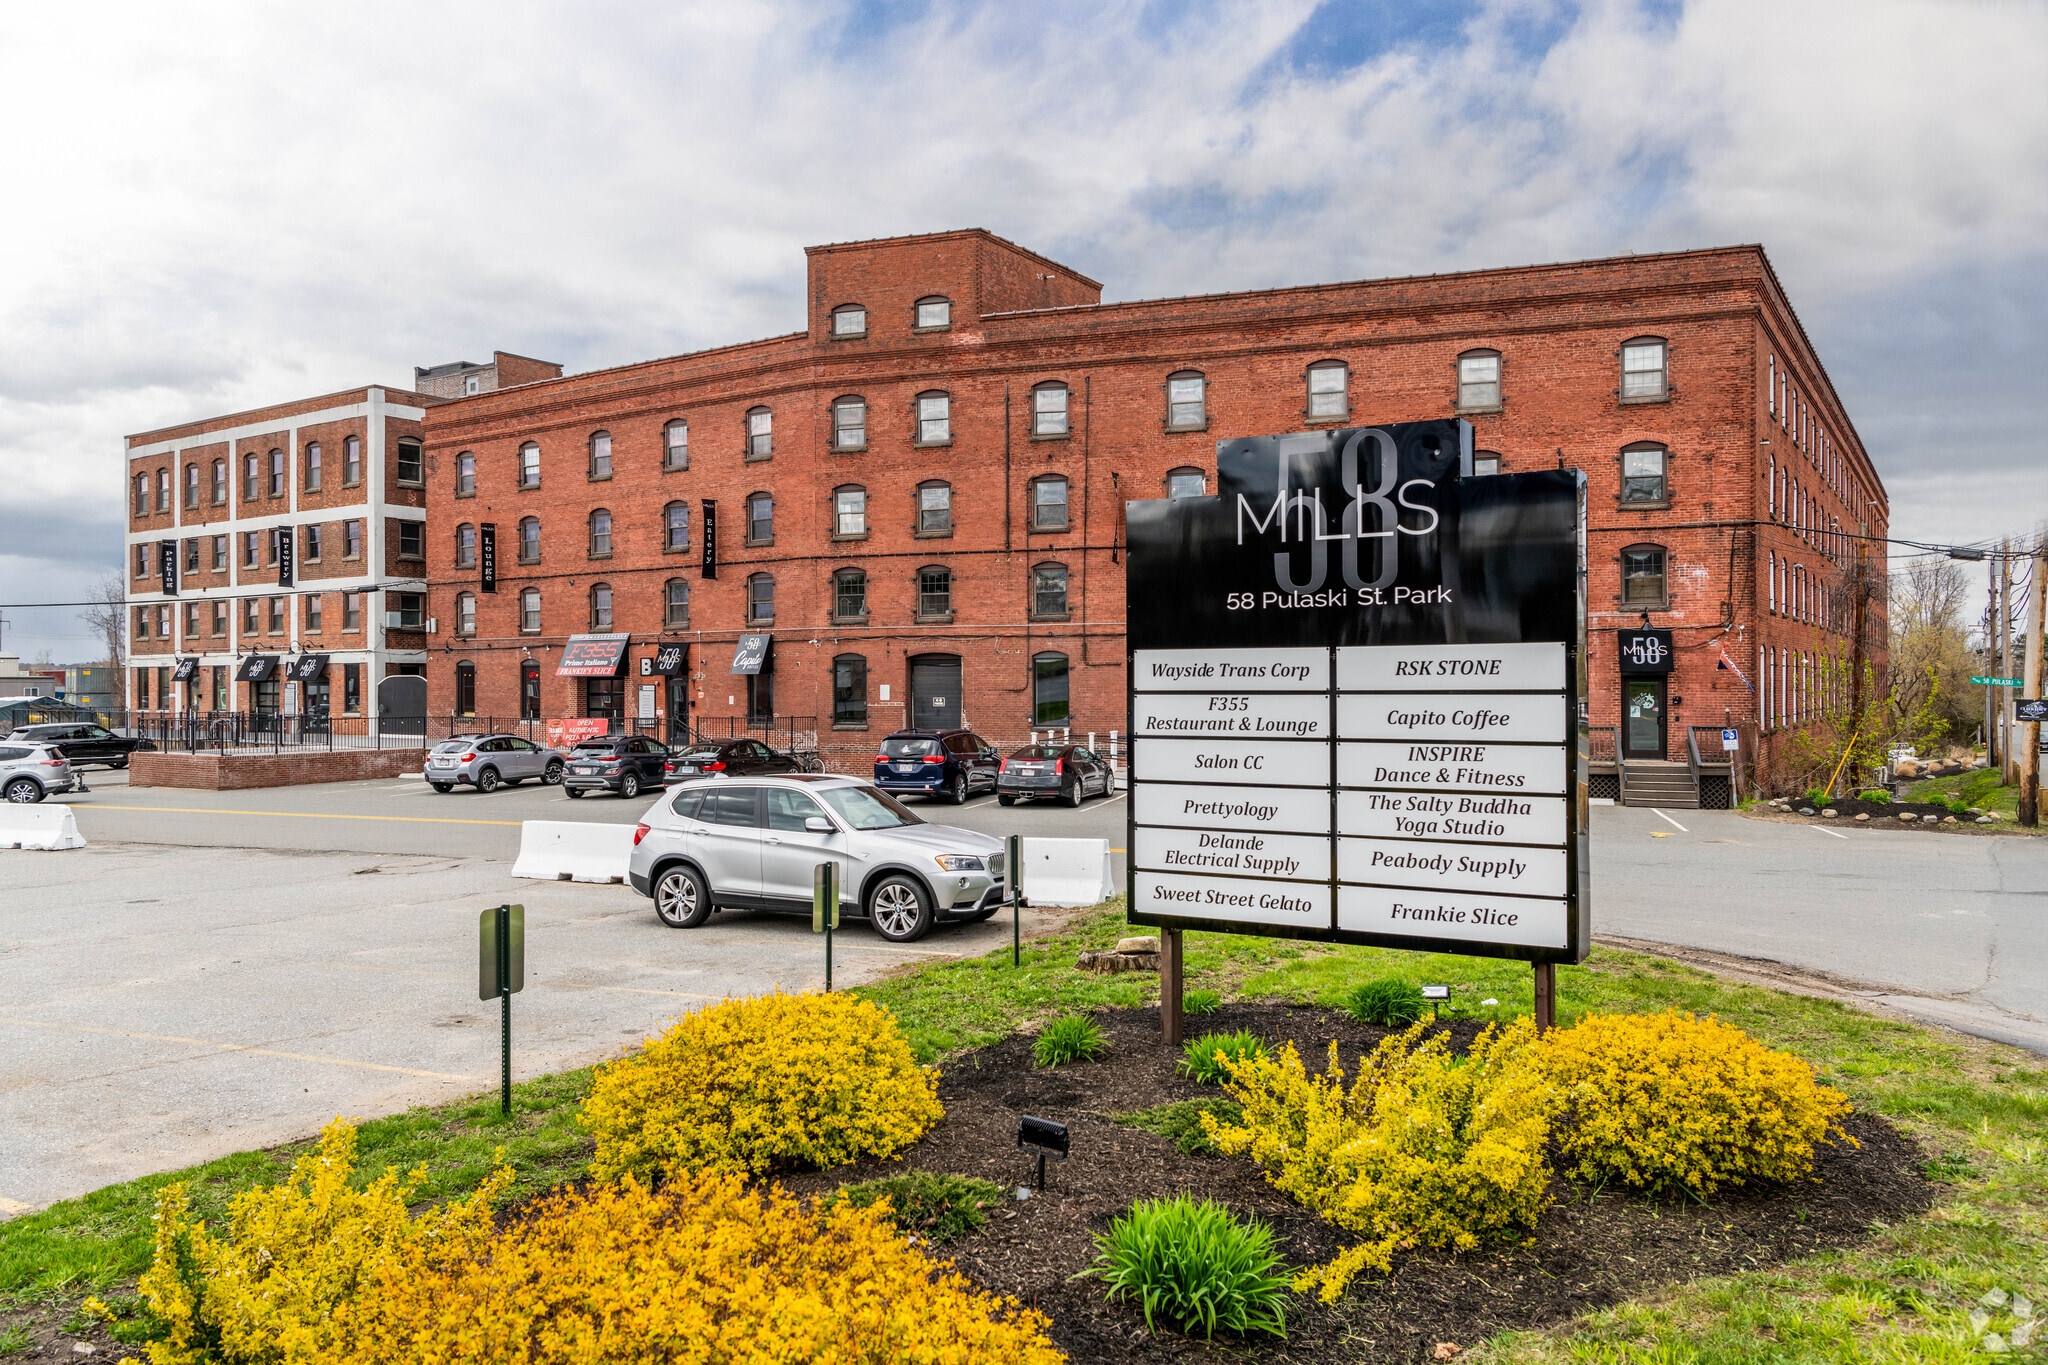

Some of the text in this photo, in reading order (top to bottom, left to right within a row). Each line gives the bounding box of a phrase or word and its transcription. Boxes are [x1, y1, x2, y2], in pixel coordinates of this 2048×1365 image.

[1236, 478, 1440, 546] MILLS
[1274, 428, 1399, 596] 58
[705, 518, 713, 564] Eatery
[282, 537, 291, 578] Brewery
[484, 537, 493, 581] Lounge
[165, 550, 174, 588] Parking
[1226, 584, 1453, 610] 58 Pulaski St. Park
[565, 641, 621, 659] F355
[659, 647, 681, 670] 58
[1623, 645, 1668, 656] MILLS
[1632, 636, 1660, 665] 58
[564, 659, 608, 667] Prime Italiano
[593, 667, 613, 675] SLICE
[641, 658, 652, 676] B
[1152, 663, 1310, 682] Wayside Trans Corp
[1395, 659, 1502, 676] RSK STONE
[1991, 678, 2014, 686] PULASKI
[1208, 697, 1249, 711] F355
[1146, 716, 1318, 736] Restaurant & Lounge
[1387, 709, 1510, 730] Capito Coffee
[1194, 754, 1264, 771] Salon CC
[1407, 746, 1486, 762] INSPIRE
[1373, 767, 1525, 787] Dance & Fitness
[1183, 799, 1279, 821] Prettyology
[1368, 794, 1532, 816] The Salty Buddha
[1395, 816, 1505, 836] Yoga Studio
[1198, 833, 1265, 851] Delande
[1164, 850, 1300, 876] Electrical Supply
[1370, 851, 1527, 880] Peabody Supply
[1153, 885, 1312, 913] Sweet Street Gelato
[1390, 903, 1519, 927] Frankie Slice
